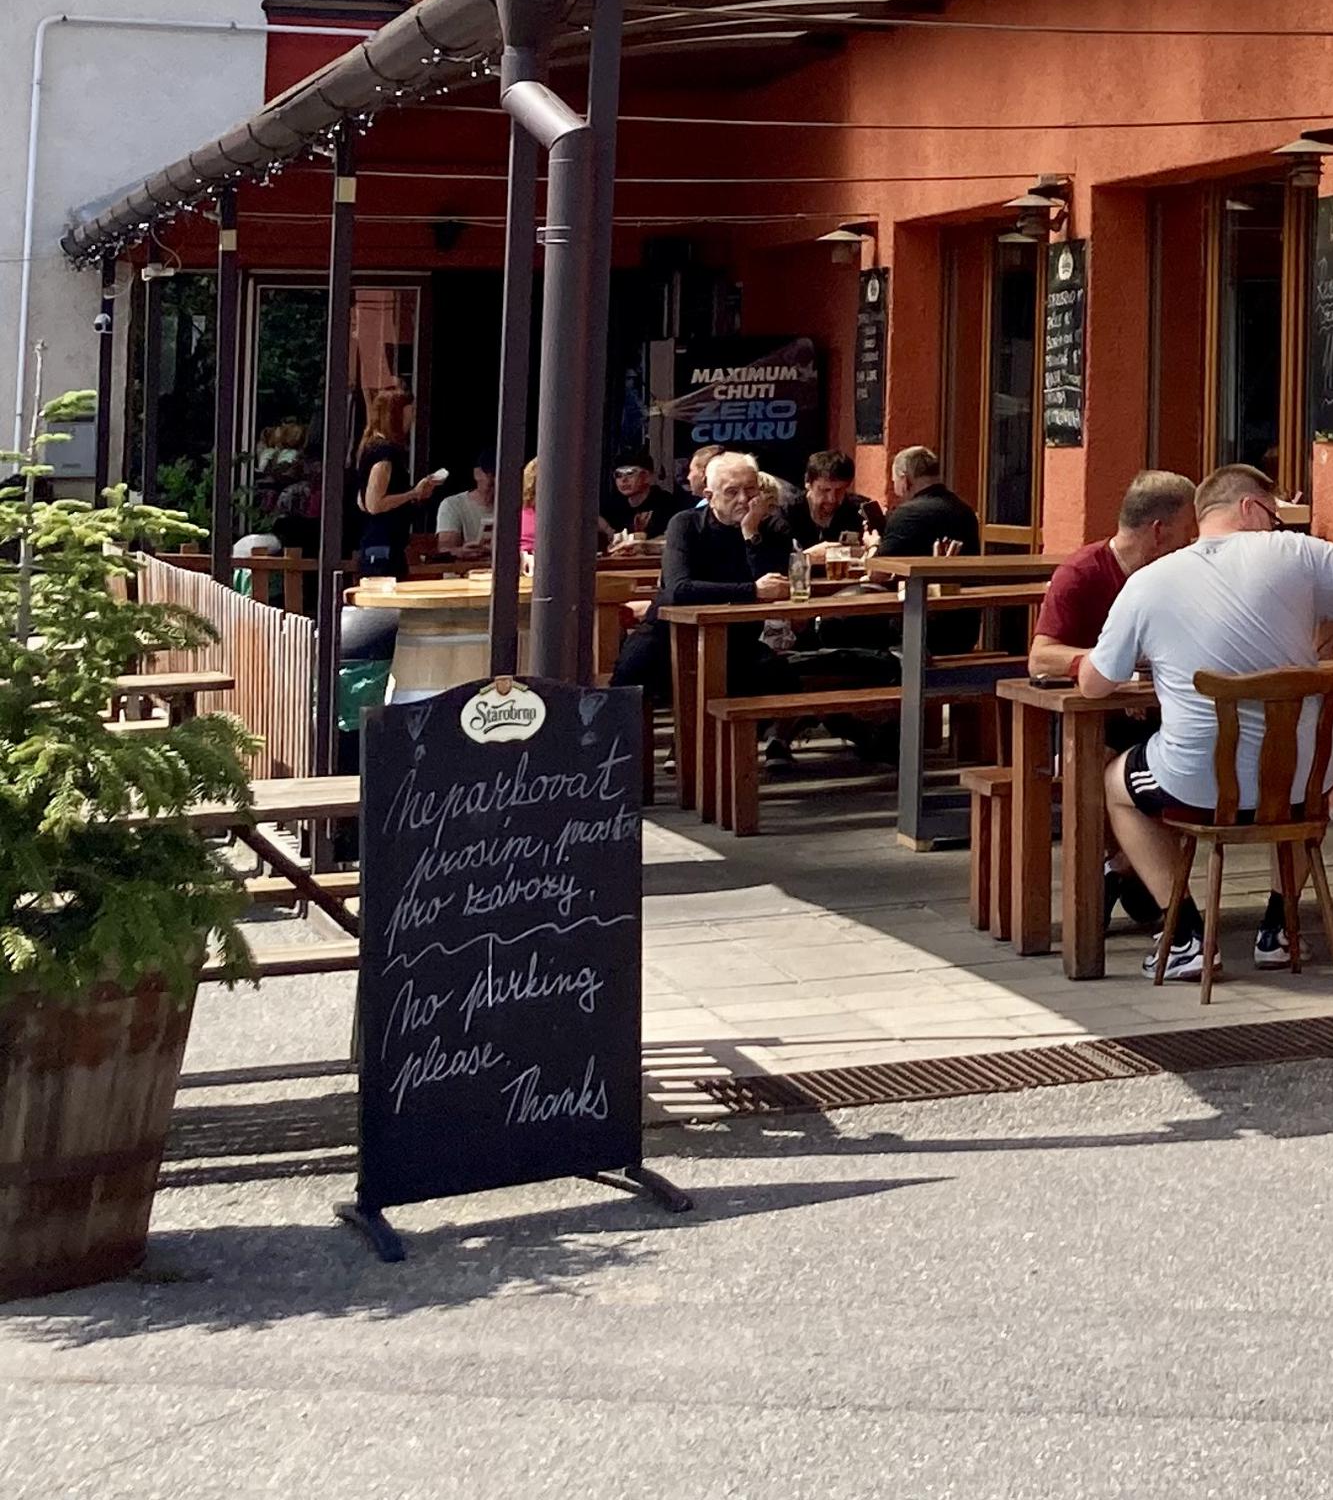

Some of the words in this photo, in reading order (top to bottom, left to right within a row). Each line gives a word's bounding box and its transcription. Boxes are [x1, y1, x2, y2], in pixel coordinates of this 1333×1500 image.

[691, 366, 799, 384] MAXIMUM
[713, 383, 775, 400] CHUTI
[694, 400, 798, 421] ZERO
[691, 420, 798, 443] CUKRU
[384, 895, 456, 957] pro
[459, 950, 604, 1034] parking
[501, 1055, 609, 1125] Thanks
